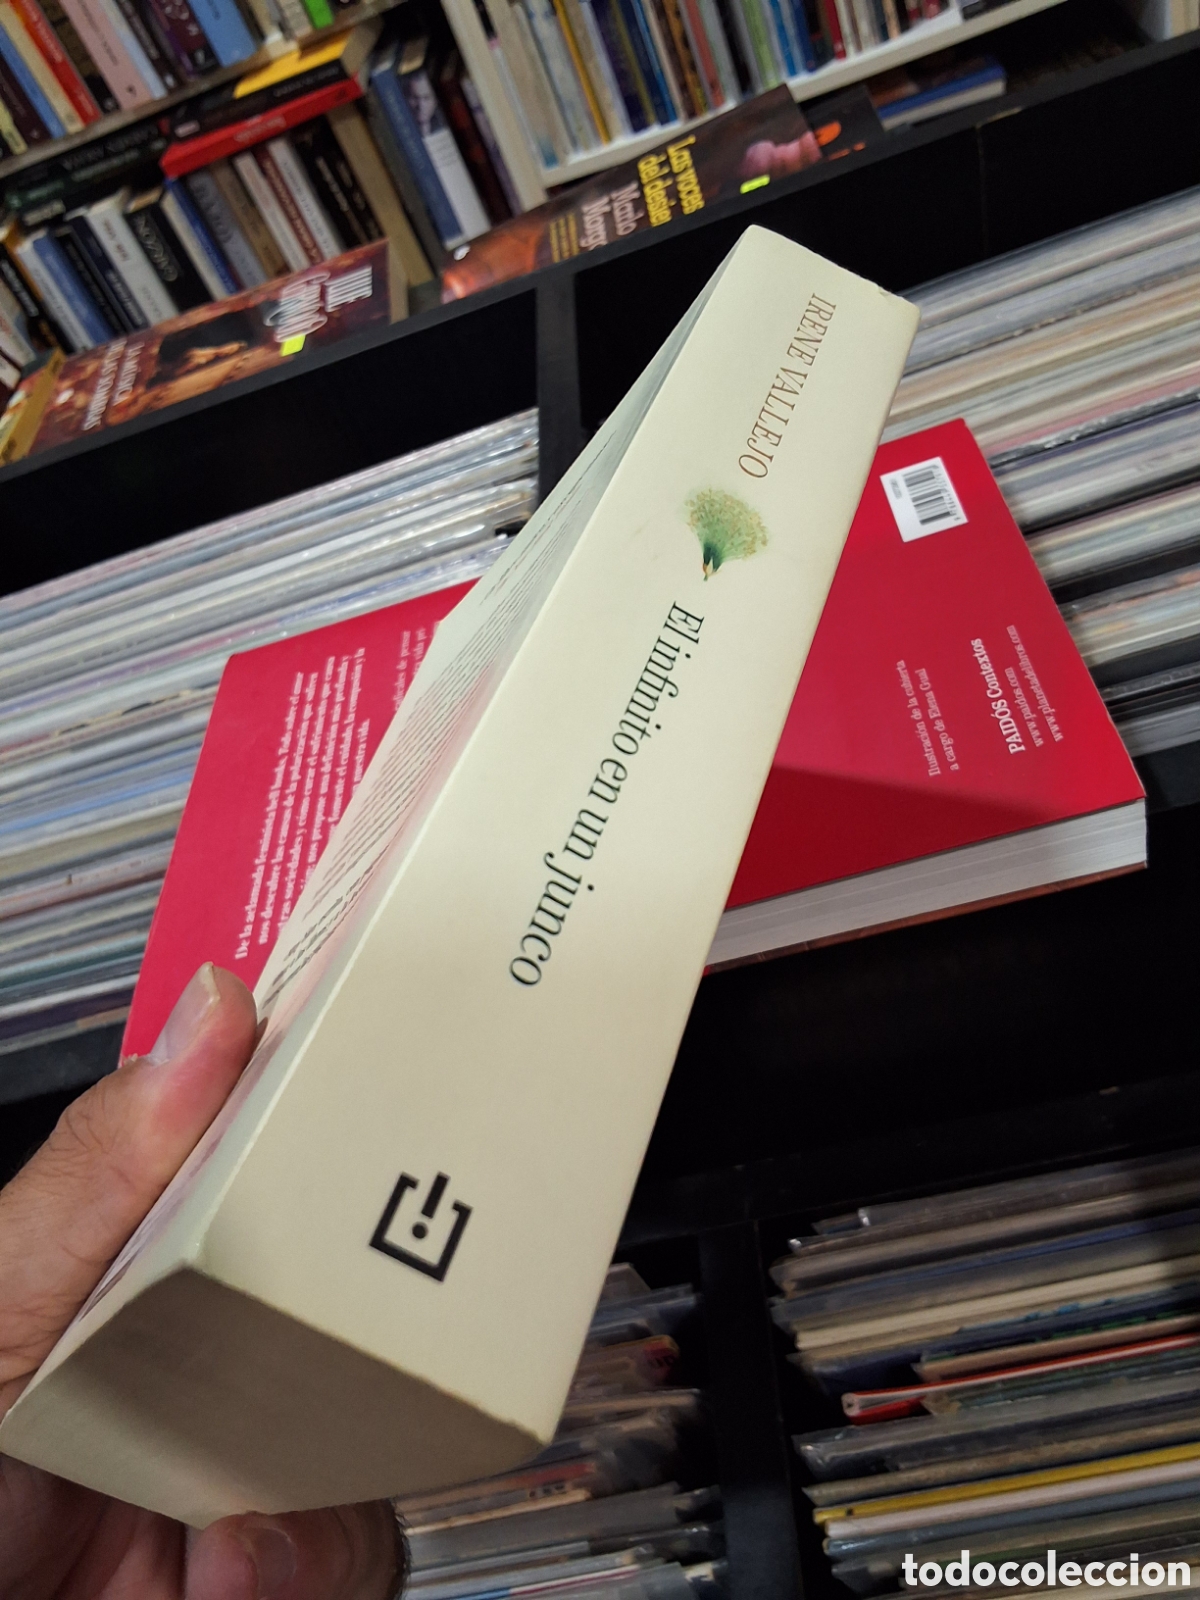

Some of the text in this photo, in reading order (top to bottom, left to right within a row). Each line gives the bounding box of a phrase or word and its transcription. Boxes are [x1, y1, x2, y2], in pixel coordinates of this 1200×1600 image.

[638, 154, 670, 184] del
[677, 168, 705, 215] voces
[738, 292, 837, 478] IRENE VALLEJO
[401, 632, 409, 656] pensar
[397, 661, 406, 669] de
[1006, 624, 1064, 742] www.planetadelibros.com
[290, 694, 299, 704] el
[303, 703, 313, 720] que
[970, 637, 1026, 754] PAIDÓS Contextos
[1004, 667, 1044, 747] www.paidos.com
[286, 706, 297, 730] sobre
[307, 755, 317, 766] el
[322, 682, 331, 698] que
[896, 659, 942, 777] Ilustración de la cubierta
[915, 668, 960, 771] a cargo de Elena Gual
[328, 778, 344, 824] fomente
[336, 764, 346, 776] el
[344, 712, 355, 725] la
[354, 742, 366, 784] nuestra
[283, 794, 294, 807] de
[286, 781, 297, 794] la
[508, 600, 706, 987] El infinito en un junco
[312, 796, 326, 841] propone
[271, 844, 284, 863] las
[308, 841, 318, 864] nos
[260, 865, 281, 919] descubre
[239, 924, 252, 938] la
[259, 919, 270, 944] nos
[235, 940, 249, 959] De
